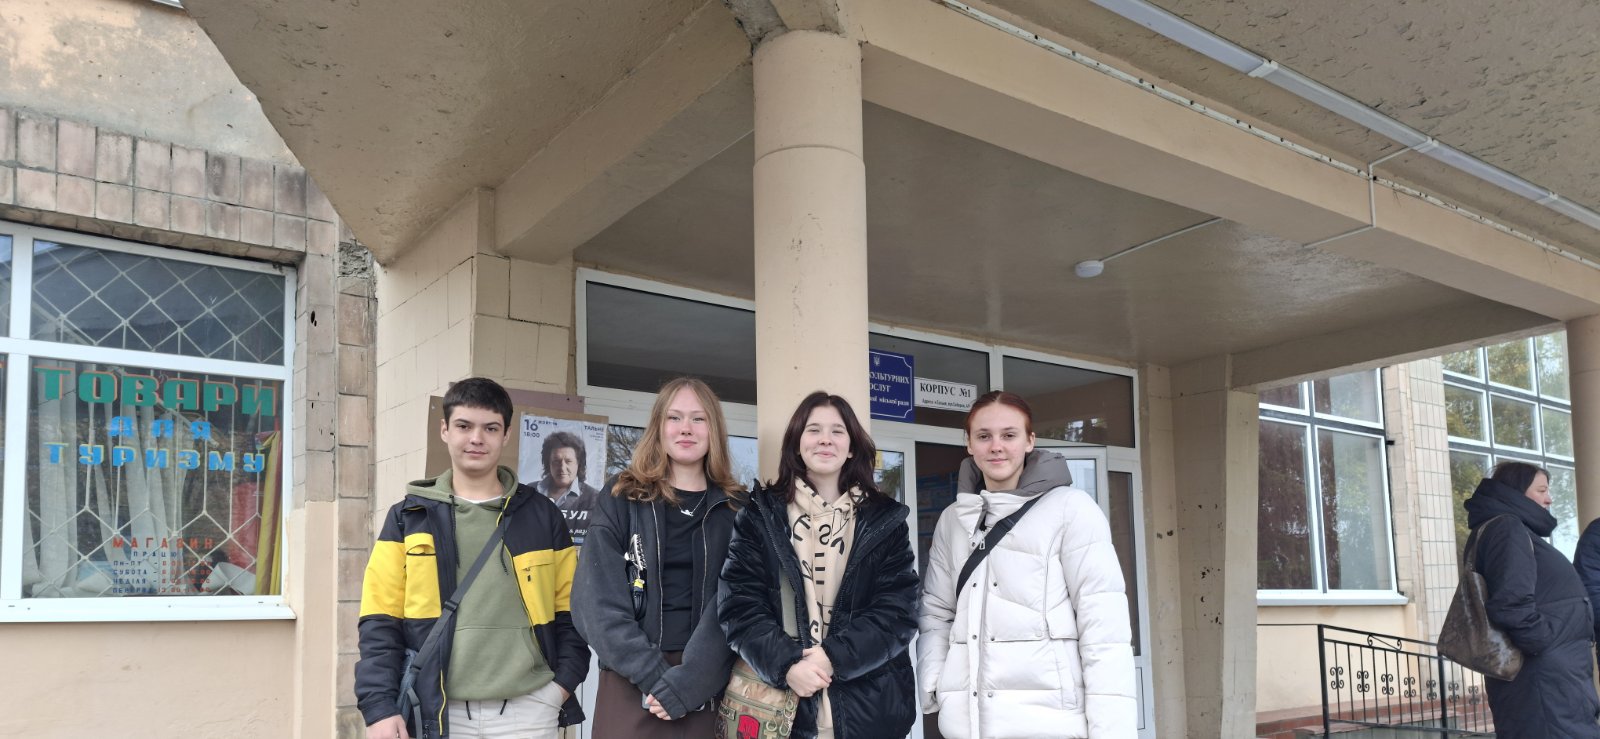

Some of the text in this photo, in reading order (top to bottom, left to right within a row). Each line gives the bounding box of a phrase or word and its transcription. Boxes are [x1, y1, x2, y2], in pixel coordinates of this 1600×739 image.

[34, 366, 278, 416] ТОВАРИ
[869, 383, 891, 392] ОСЛУГ
[920, 383, 971, 397] КОРПУС №1
[108, 415, 211, 440] ДЛЯ
[524, 419, 538, 431] 16
[44, 442, 265, 473] ТУРИЗМУ
[561, 509, 588, 520] БУЛ
[112, 537, 214, 548] МАГАЗИН
